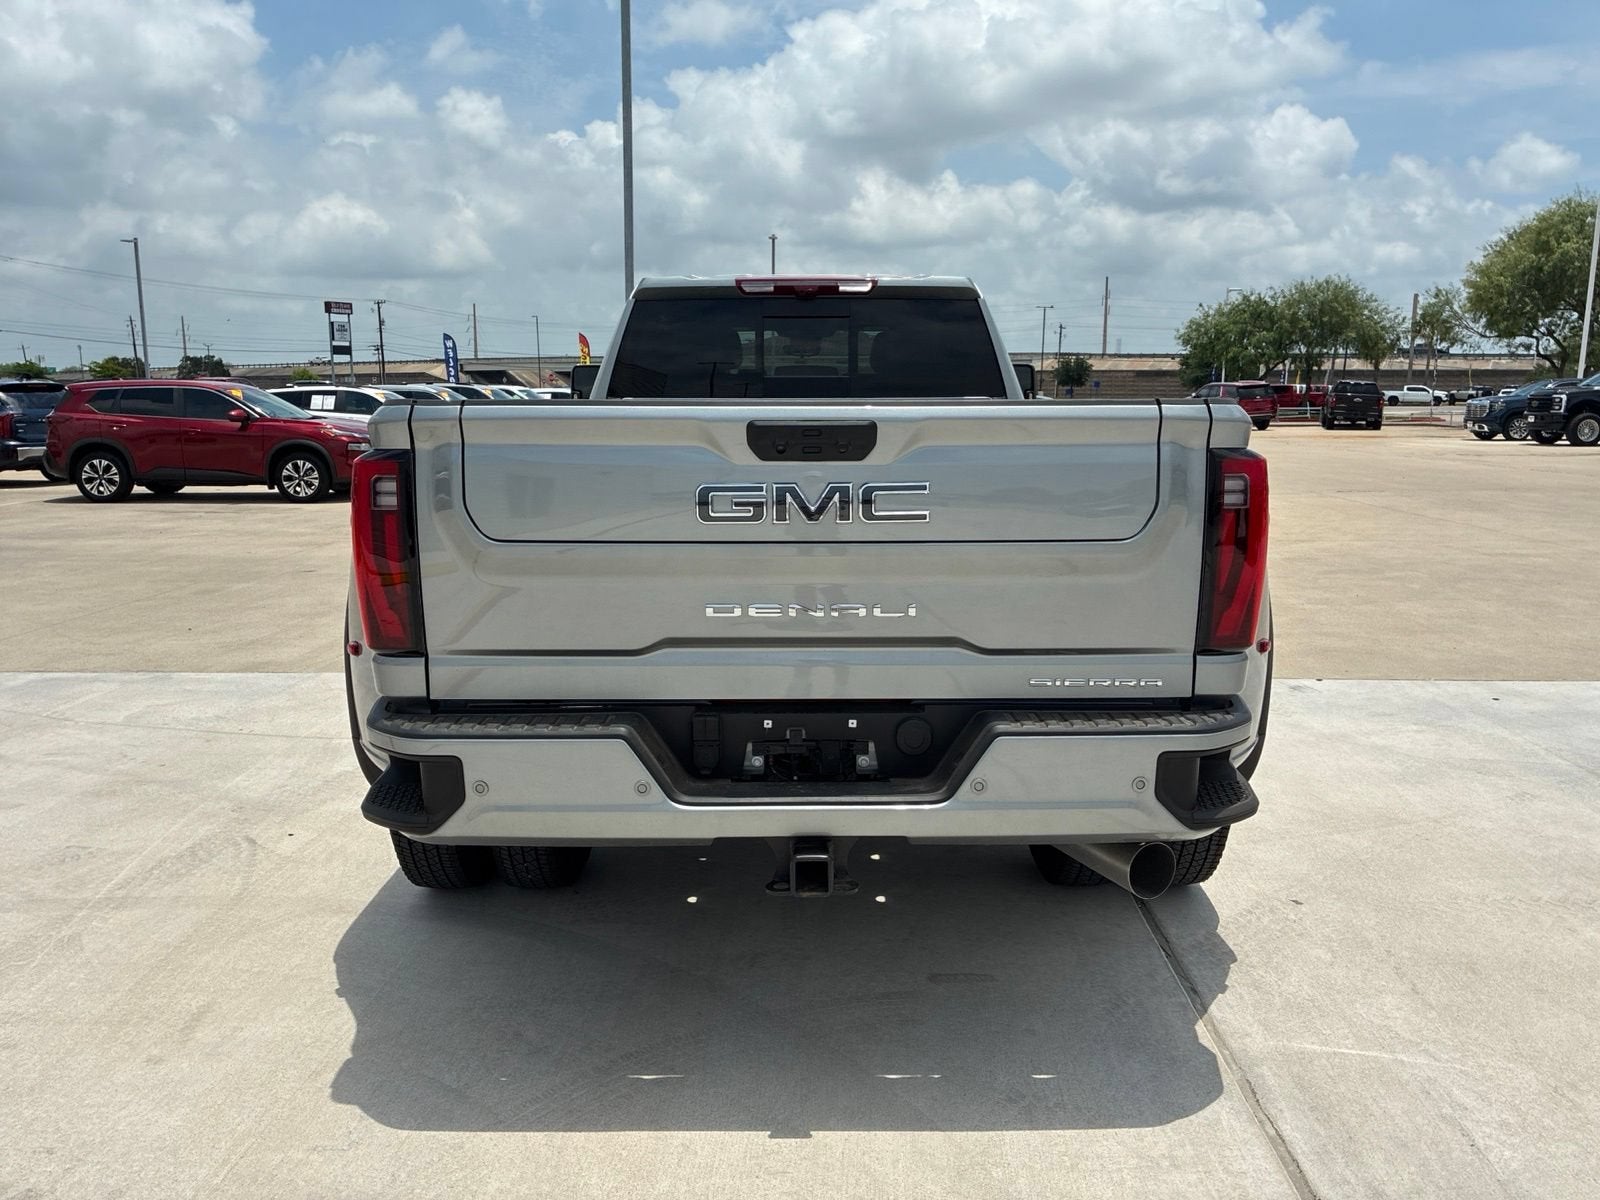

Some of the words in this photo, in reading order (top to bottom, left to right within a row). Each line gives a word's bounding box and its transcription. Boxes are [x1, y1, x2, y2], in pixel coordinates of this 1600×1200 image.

[695, 482, 930, 525] GMC
[705, 603, 917, 617] DENALI
[1029, 678, 1163, 688] SIERRA
